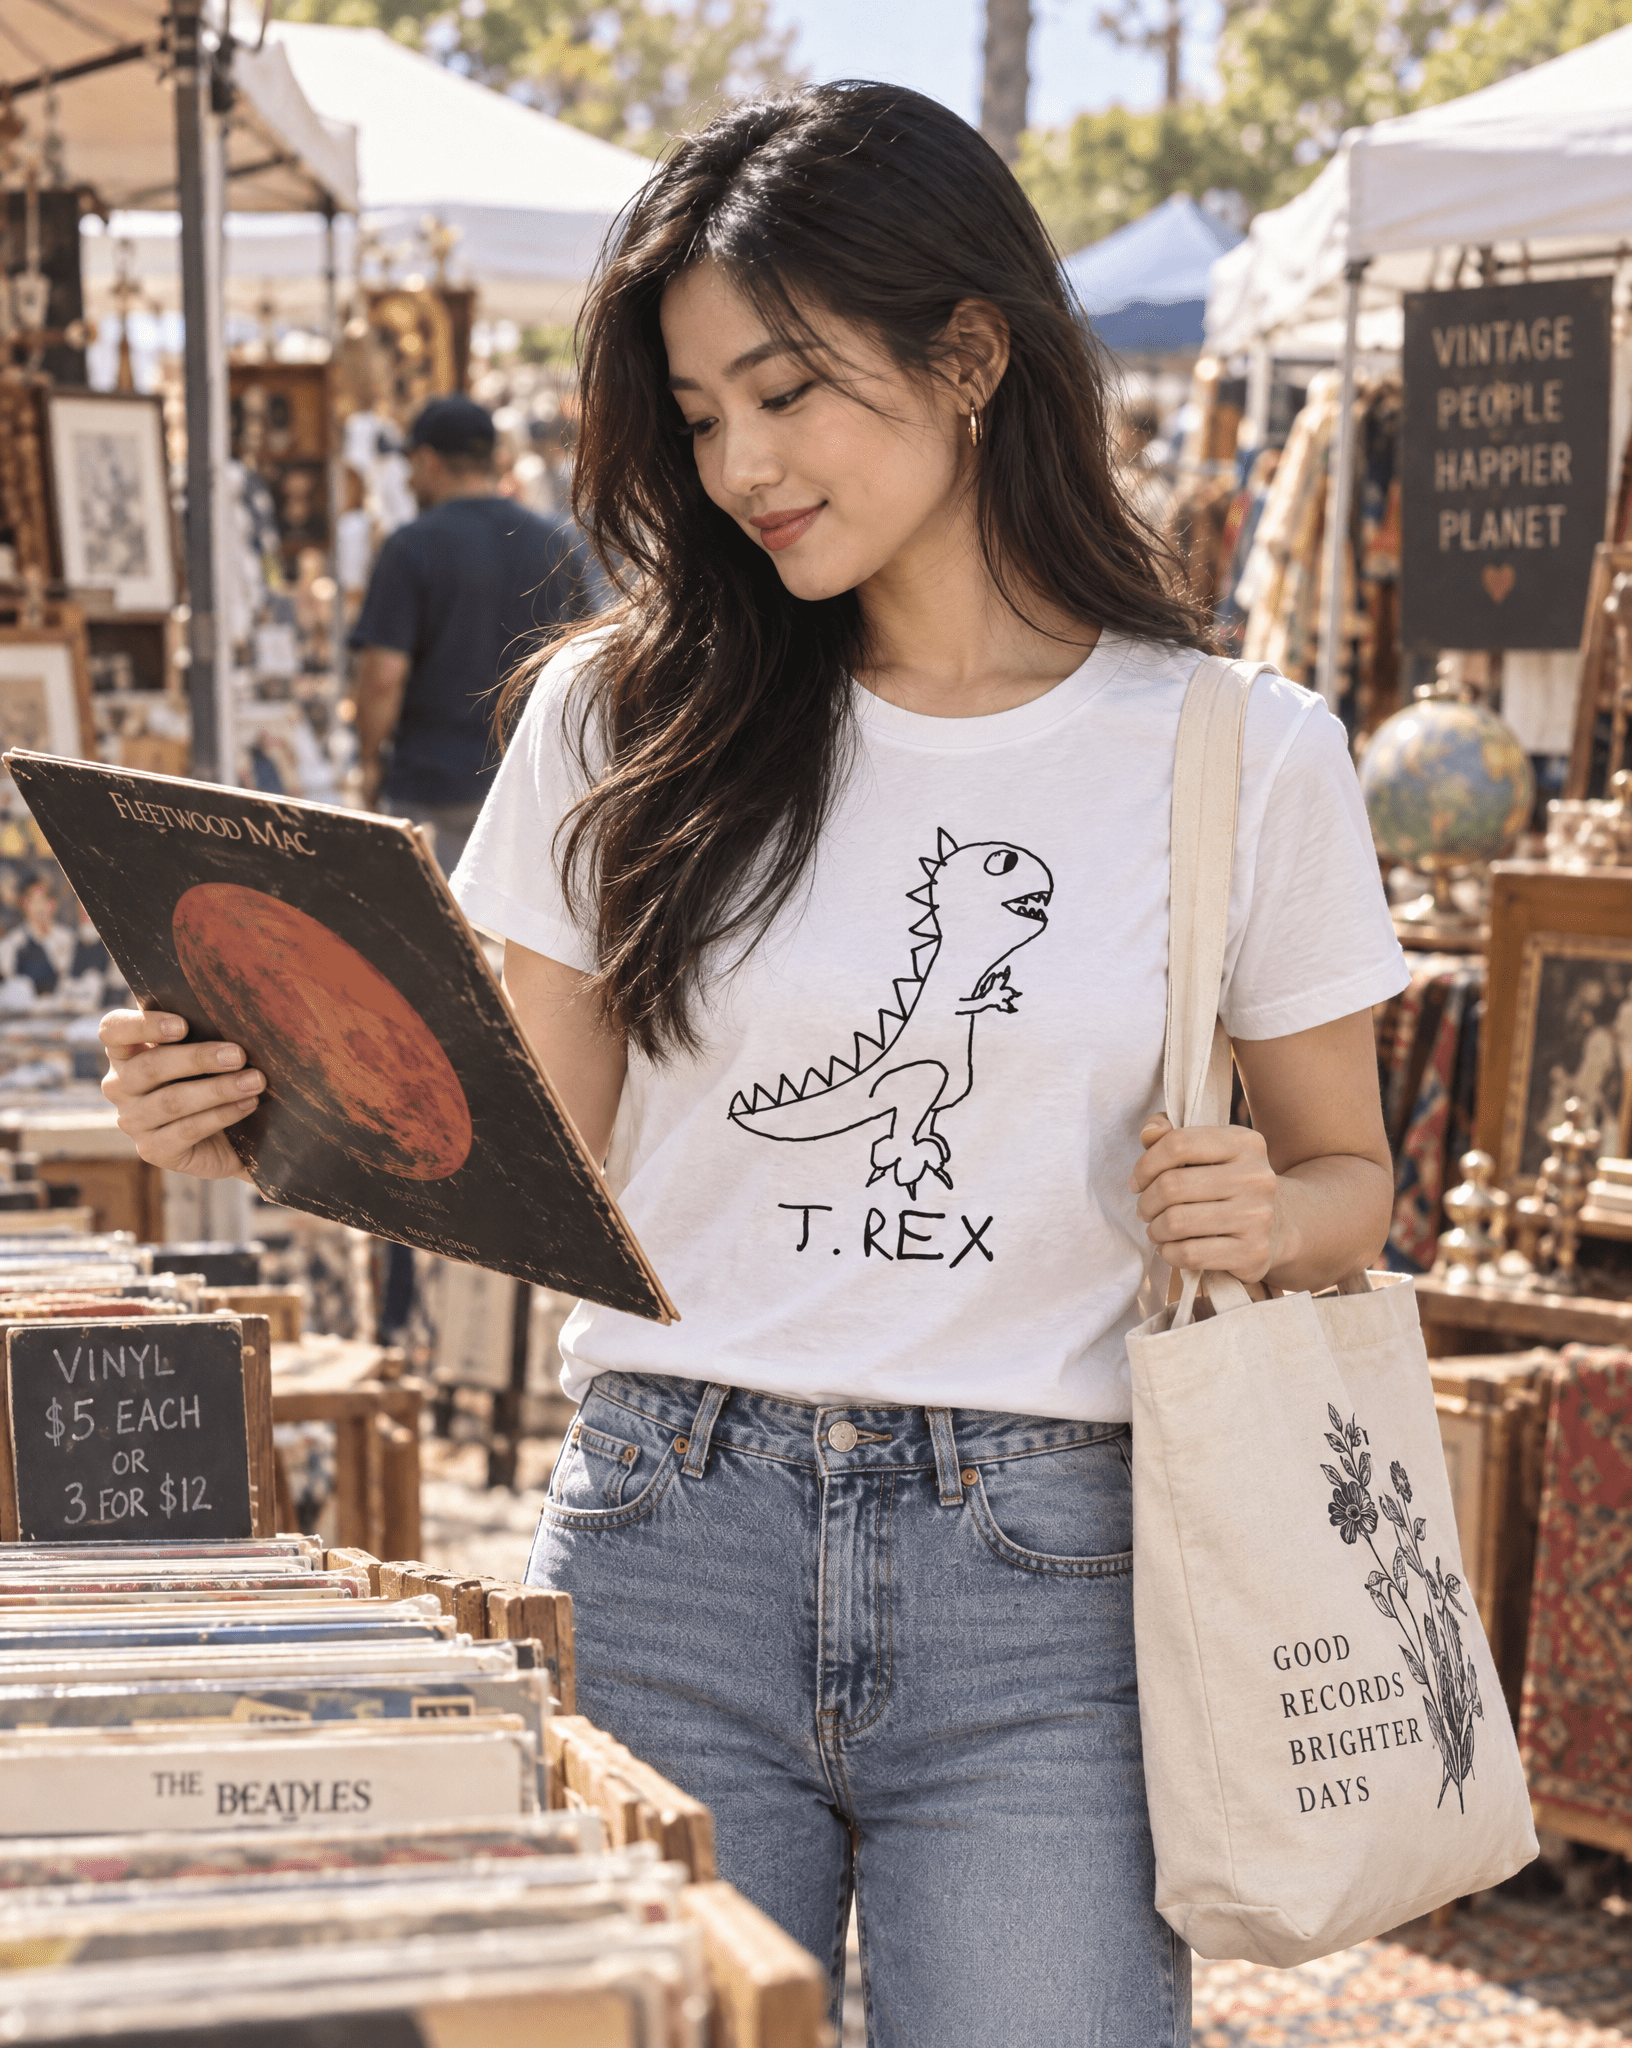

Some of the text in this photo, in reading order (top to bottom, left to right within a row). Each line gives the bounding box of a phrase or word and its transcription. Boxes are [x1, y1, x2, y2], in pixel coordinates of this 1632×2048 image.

[1432, 315, 1574, 368] VINTAGE
[1436, 379, 1564, 431] PEOPLE
[1434, 442, 1572, 492] HAPPIER
[1438, 504, 1567, 551] PLANET
[108, 791, 316, 856] FLEETWOOD MAC
[777, 1202, 994, 1269] T. REX
[53, 1344, 175, 1384] VINYL
[45, 1394, 201, 1447] $5 EACH
[112, 1448, 149, 1475] OR
[64, 1472, 212, 1524] 3 FOR $12
[1273, 1634, 1350, 1671] GOOD
[1280, 1672, 1404, 1718] RECORDS
[1288, 1717, 1423, 1766] BRIGHTER
[151, 1770, 204, 1797] THE
[1296, 1776, 1370, 1813] DAYS
